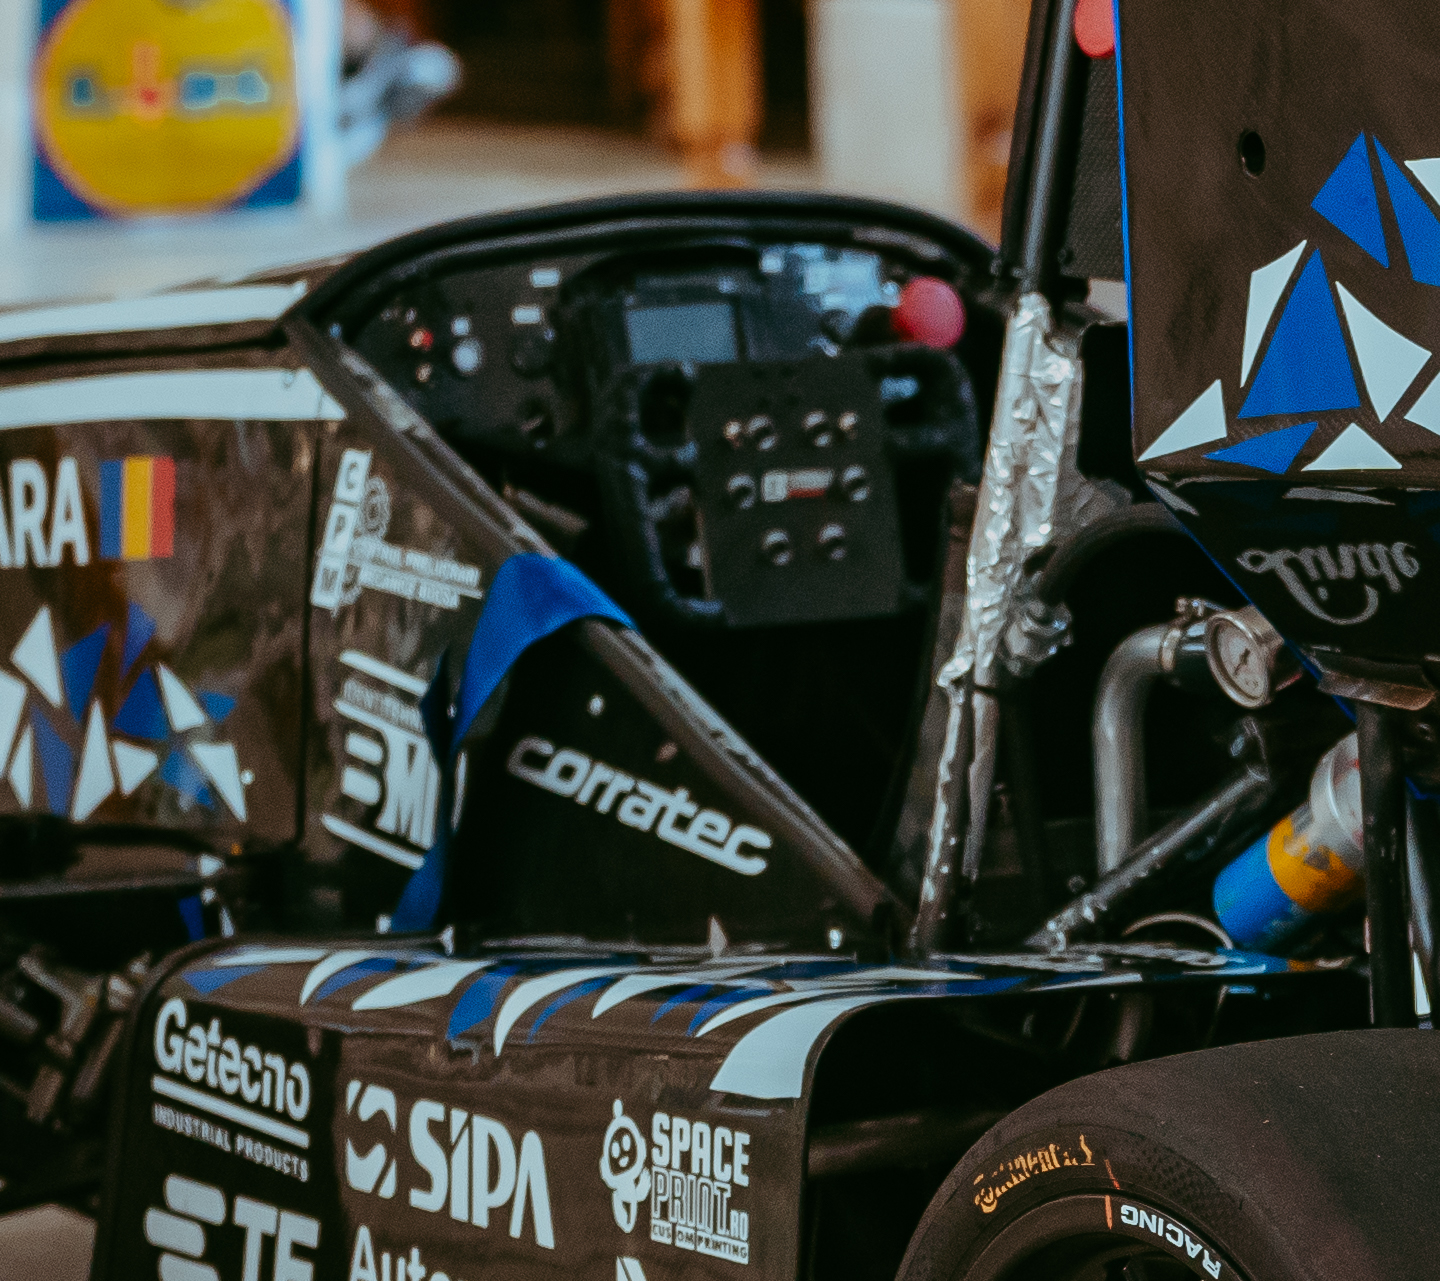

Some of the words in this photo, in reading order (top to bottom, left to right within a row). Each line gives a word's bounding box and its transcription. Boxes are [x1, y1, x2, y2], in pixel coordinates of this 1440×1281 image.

[507, 736, 773, 876] corratec
[154, 998, 311, 1121] Getecno
[152, 1105, 231, 1154] INDUSTRIAL
[235, 1133, 310, 1182] PRODUCTS
[651, 1111, 750, 1188] SPACE
[1120, 1203, 1222, 1280] RACING
